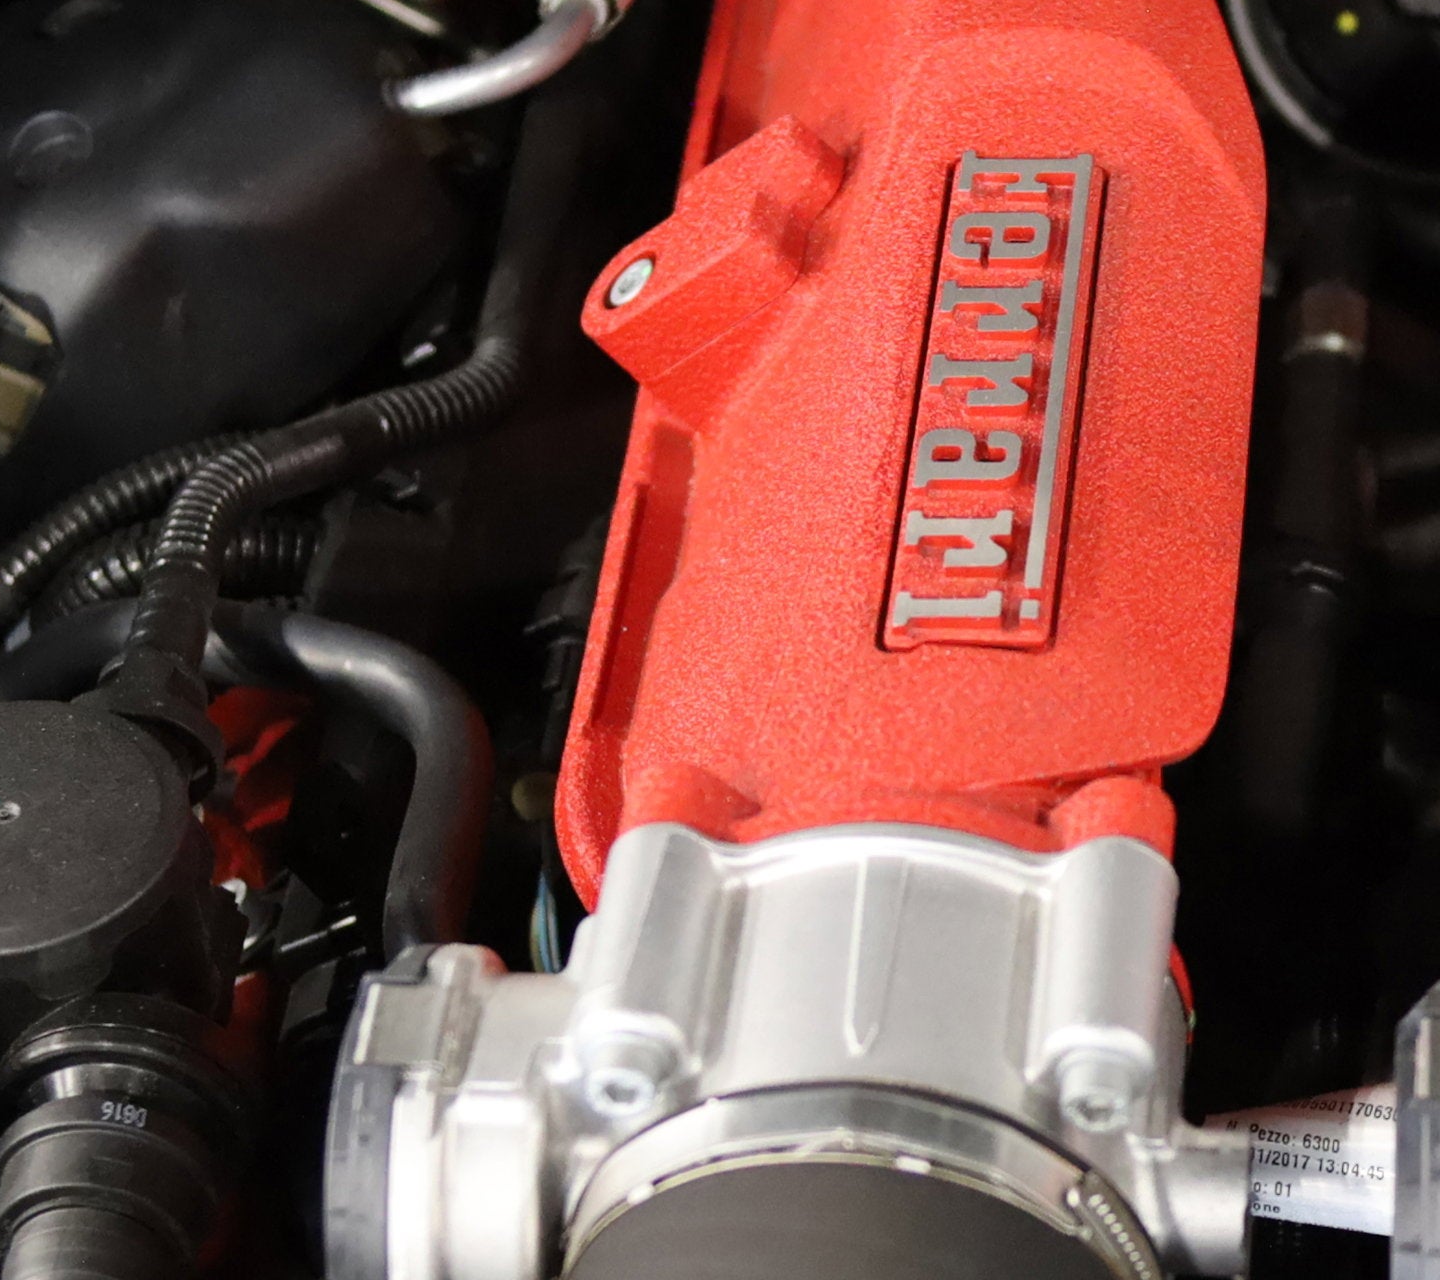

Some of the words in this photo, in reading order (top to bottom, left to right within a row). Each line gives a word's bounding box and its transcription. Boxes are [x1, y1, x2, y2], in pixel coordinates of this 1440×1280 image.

[890, 151, 1093, 634] Ferrari
[1302, 1133, 1340, 1154] 6300
[1274, 1180, 1292, 1198] 01
